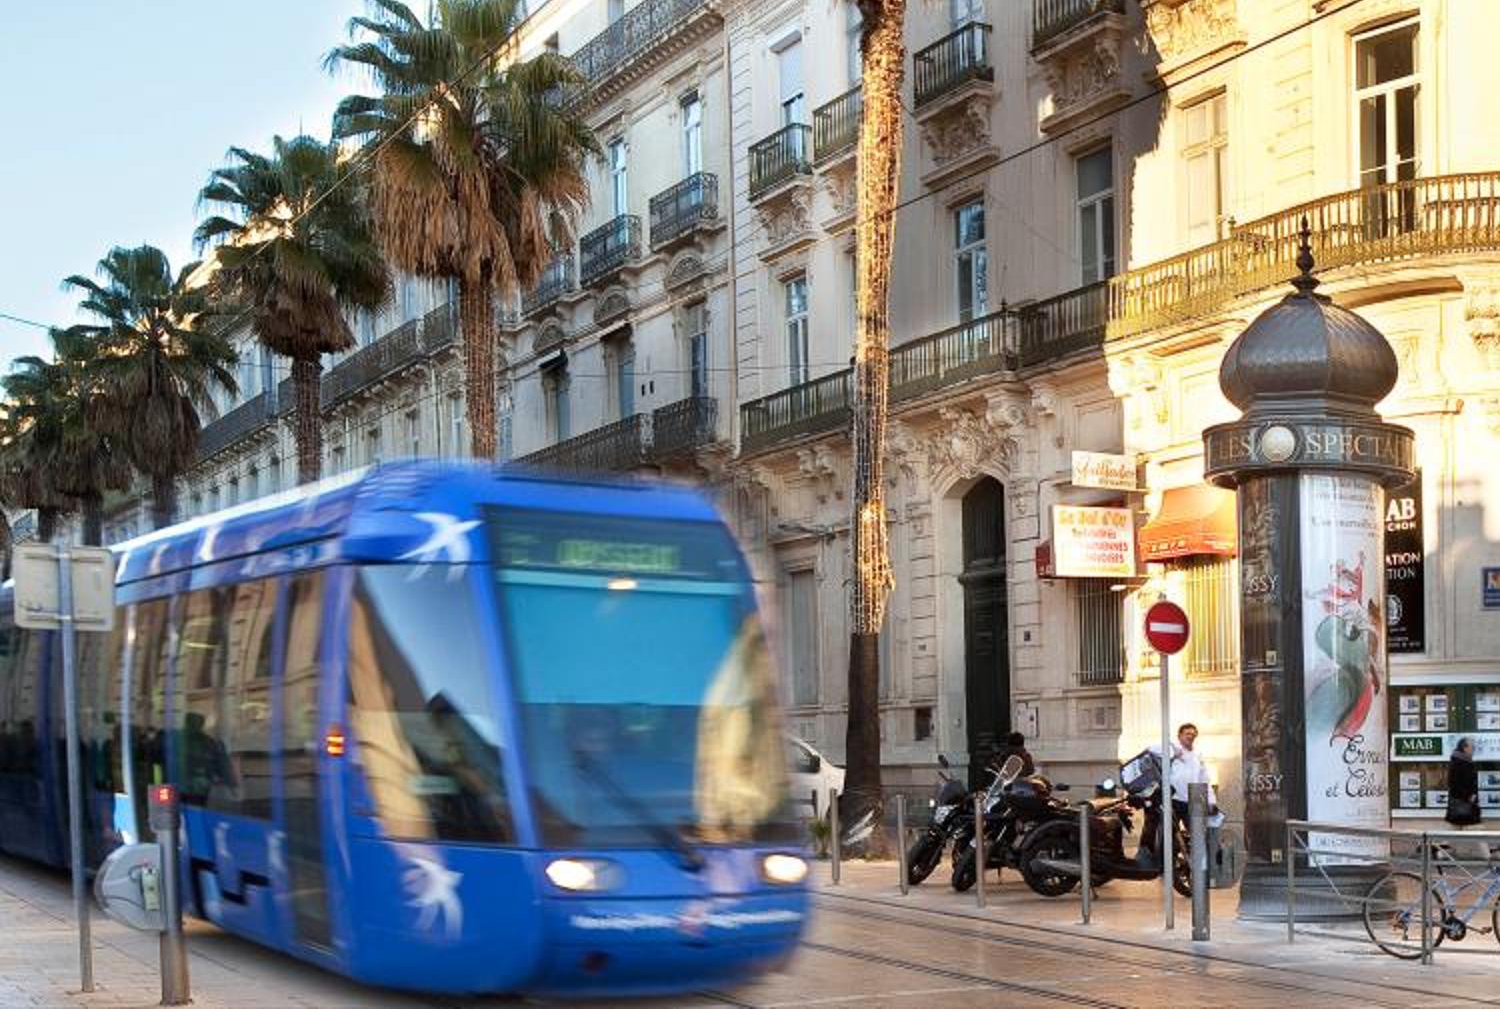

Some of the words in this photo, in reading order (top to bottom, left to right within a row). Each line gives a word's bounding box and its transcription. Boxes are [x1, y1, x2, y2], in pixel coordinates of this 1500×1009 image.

[1218, 436, 1253, 459] LES
[1385, 497, 1416, 522] AB
[1387, 522, 1416, 532] CHON
[1402, 738, 1434, 751] MAB
[1325, 783, 1340, 798] et
